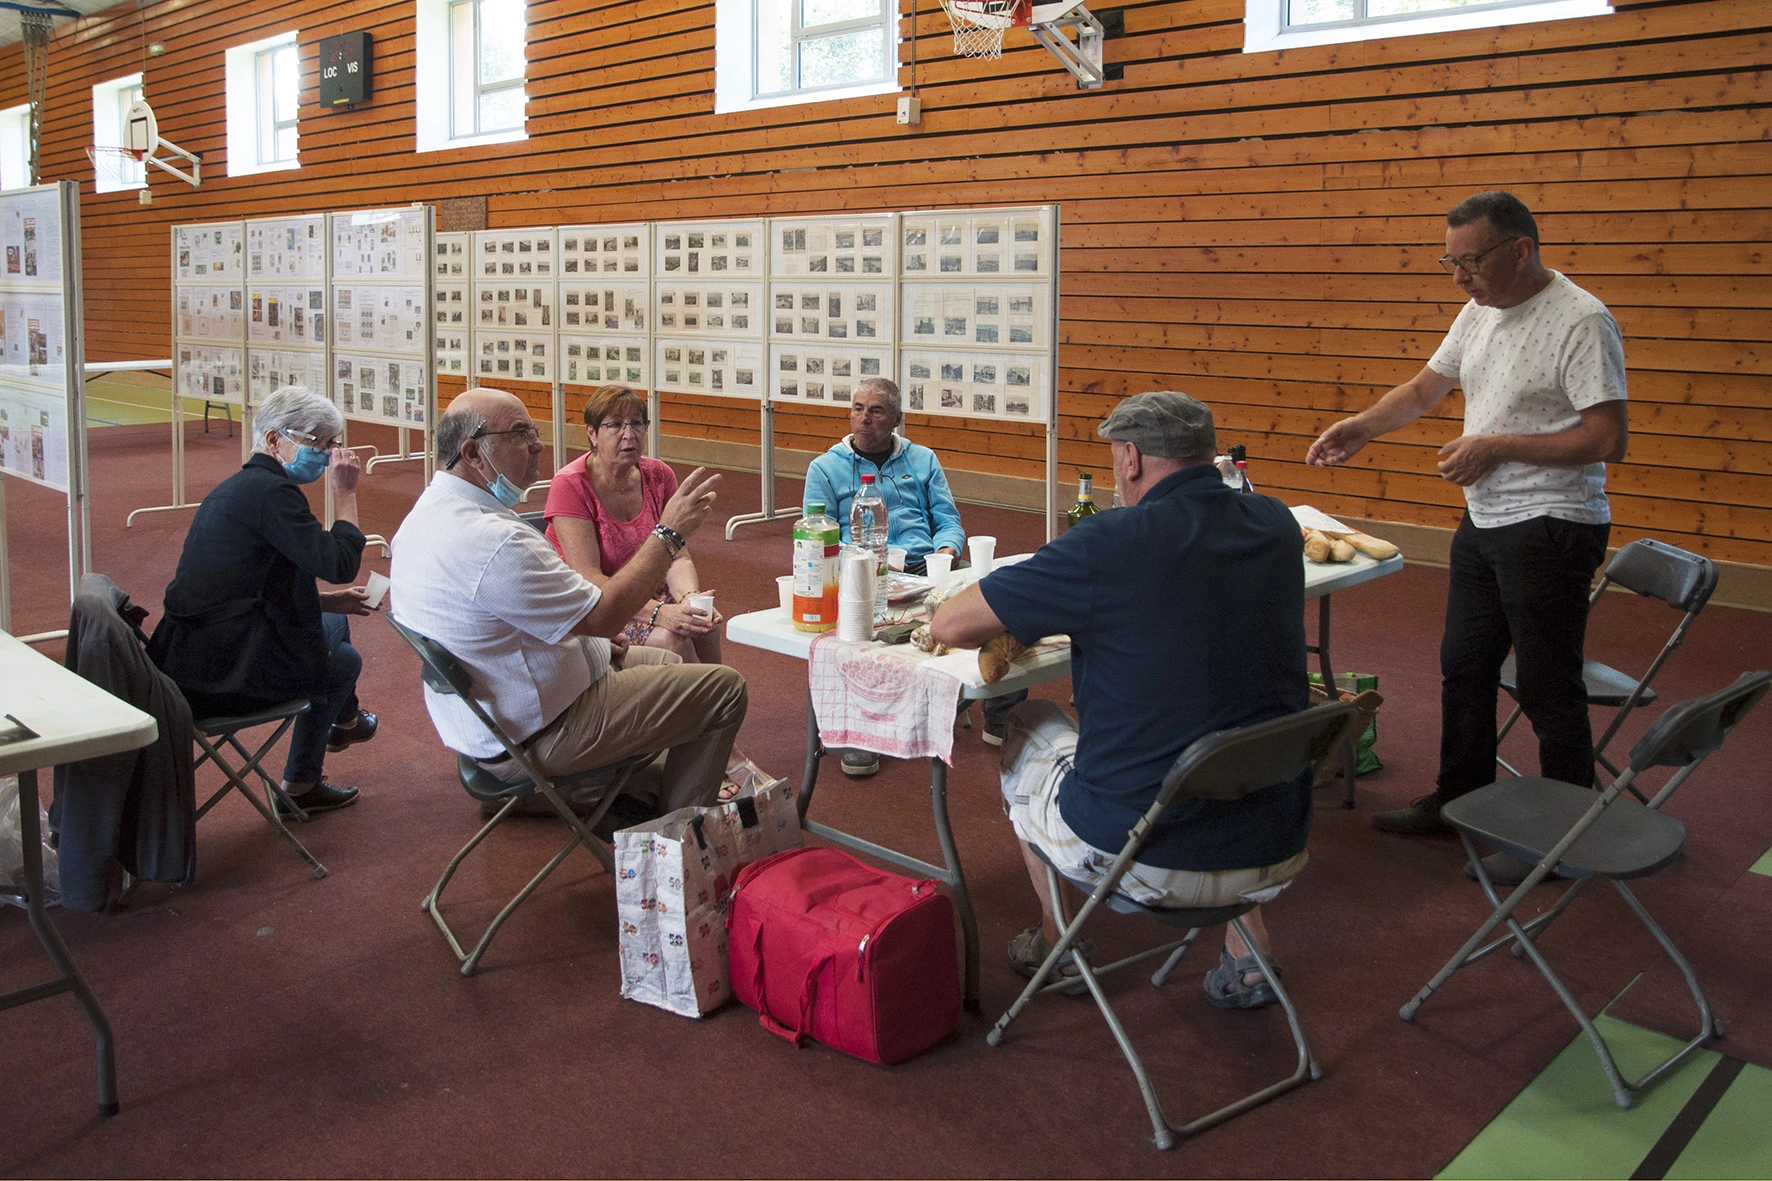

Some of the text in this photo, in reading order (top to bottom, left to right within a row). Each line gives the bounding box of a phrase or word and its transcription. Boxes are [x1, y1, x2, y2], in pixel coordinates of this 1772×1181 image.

[323, 61, 359, 79] LOC VIS
[668, 876, 683, 891] 50
[668, 933, 684, 947] 50
